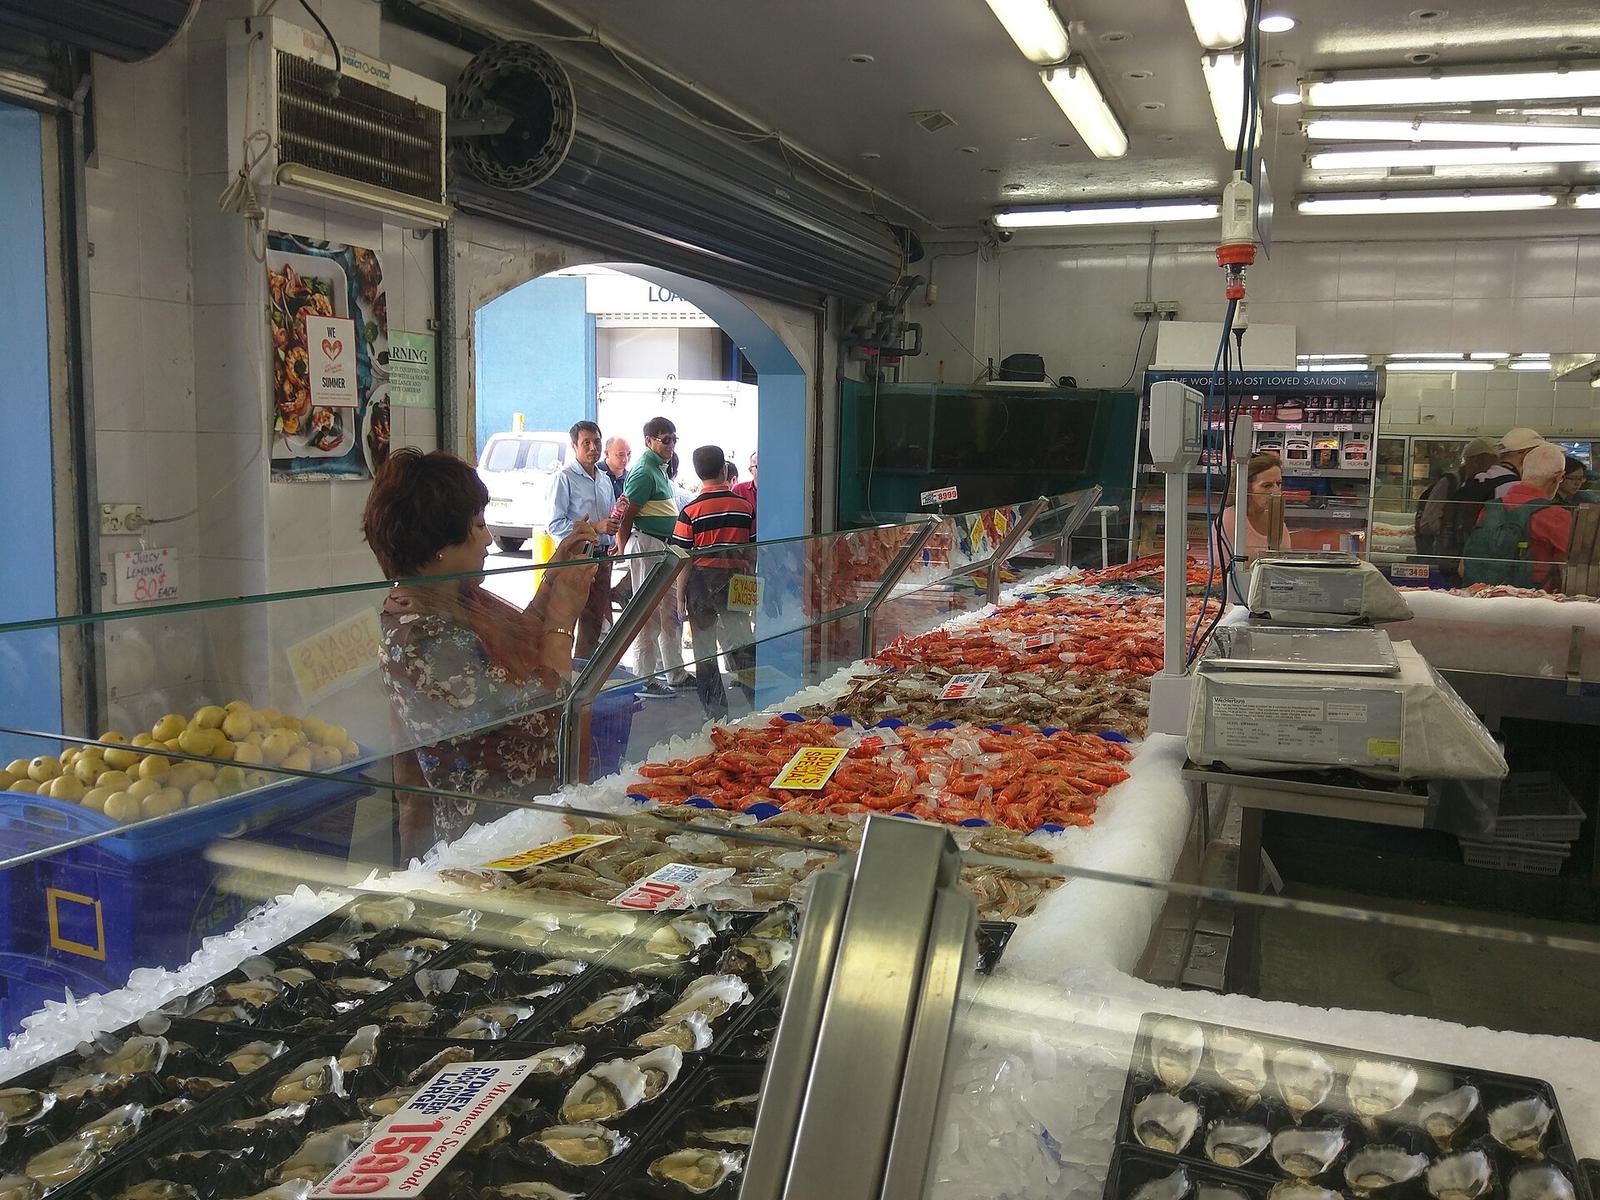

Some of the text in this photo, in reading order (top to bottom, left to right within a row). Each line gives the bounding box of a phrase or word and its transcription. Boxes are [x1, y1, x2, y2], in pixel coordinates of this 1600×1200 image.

[648, 286, 688, 302] LOA
[326, 326, 336, 338] WE
[388, 346, 428, 362] ARNING
[321, 376, 346, 389] SUMMER
[1235, 377, 1264, 386] MOST
[1267, 376, 1300, 386] LOVED
[1303, 376, 1347, 386] SALMON
[132, 551, 161, 565] JUICY
[126, 563, 164, 580] LEMONS
[1408, 568, 1429, 577] 3499
[158, 586, 178, 598] EACH
[783, 751, 822, 783] SPECIAL
[802, 752, 840, 784] TODAY'S
[407, 1072, 459, 1111] LARGE
[421, 1066, 483, 1115] ROCK OYSTERS
[445, 1067, 501, 1113] SYDNEY
[399, 1081, 513, 1192] Musumeci Seafoods
